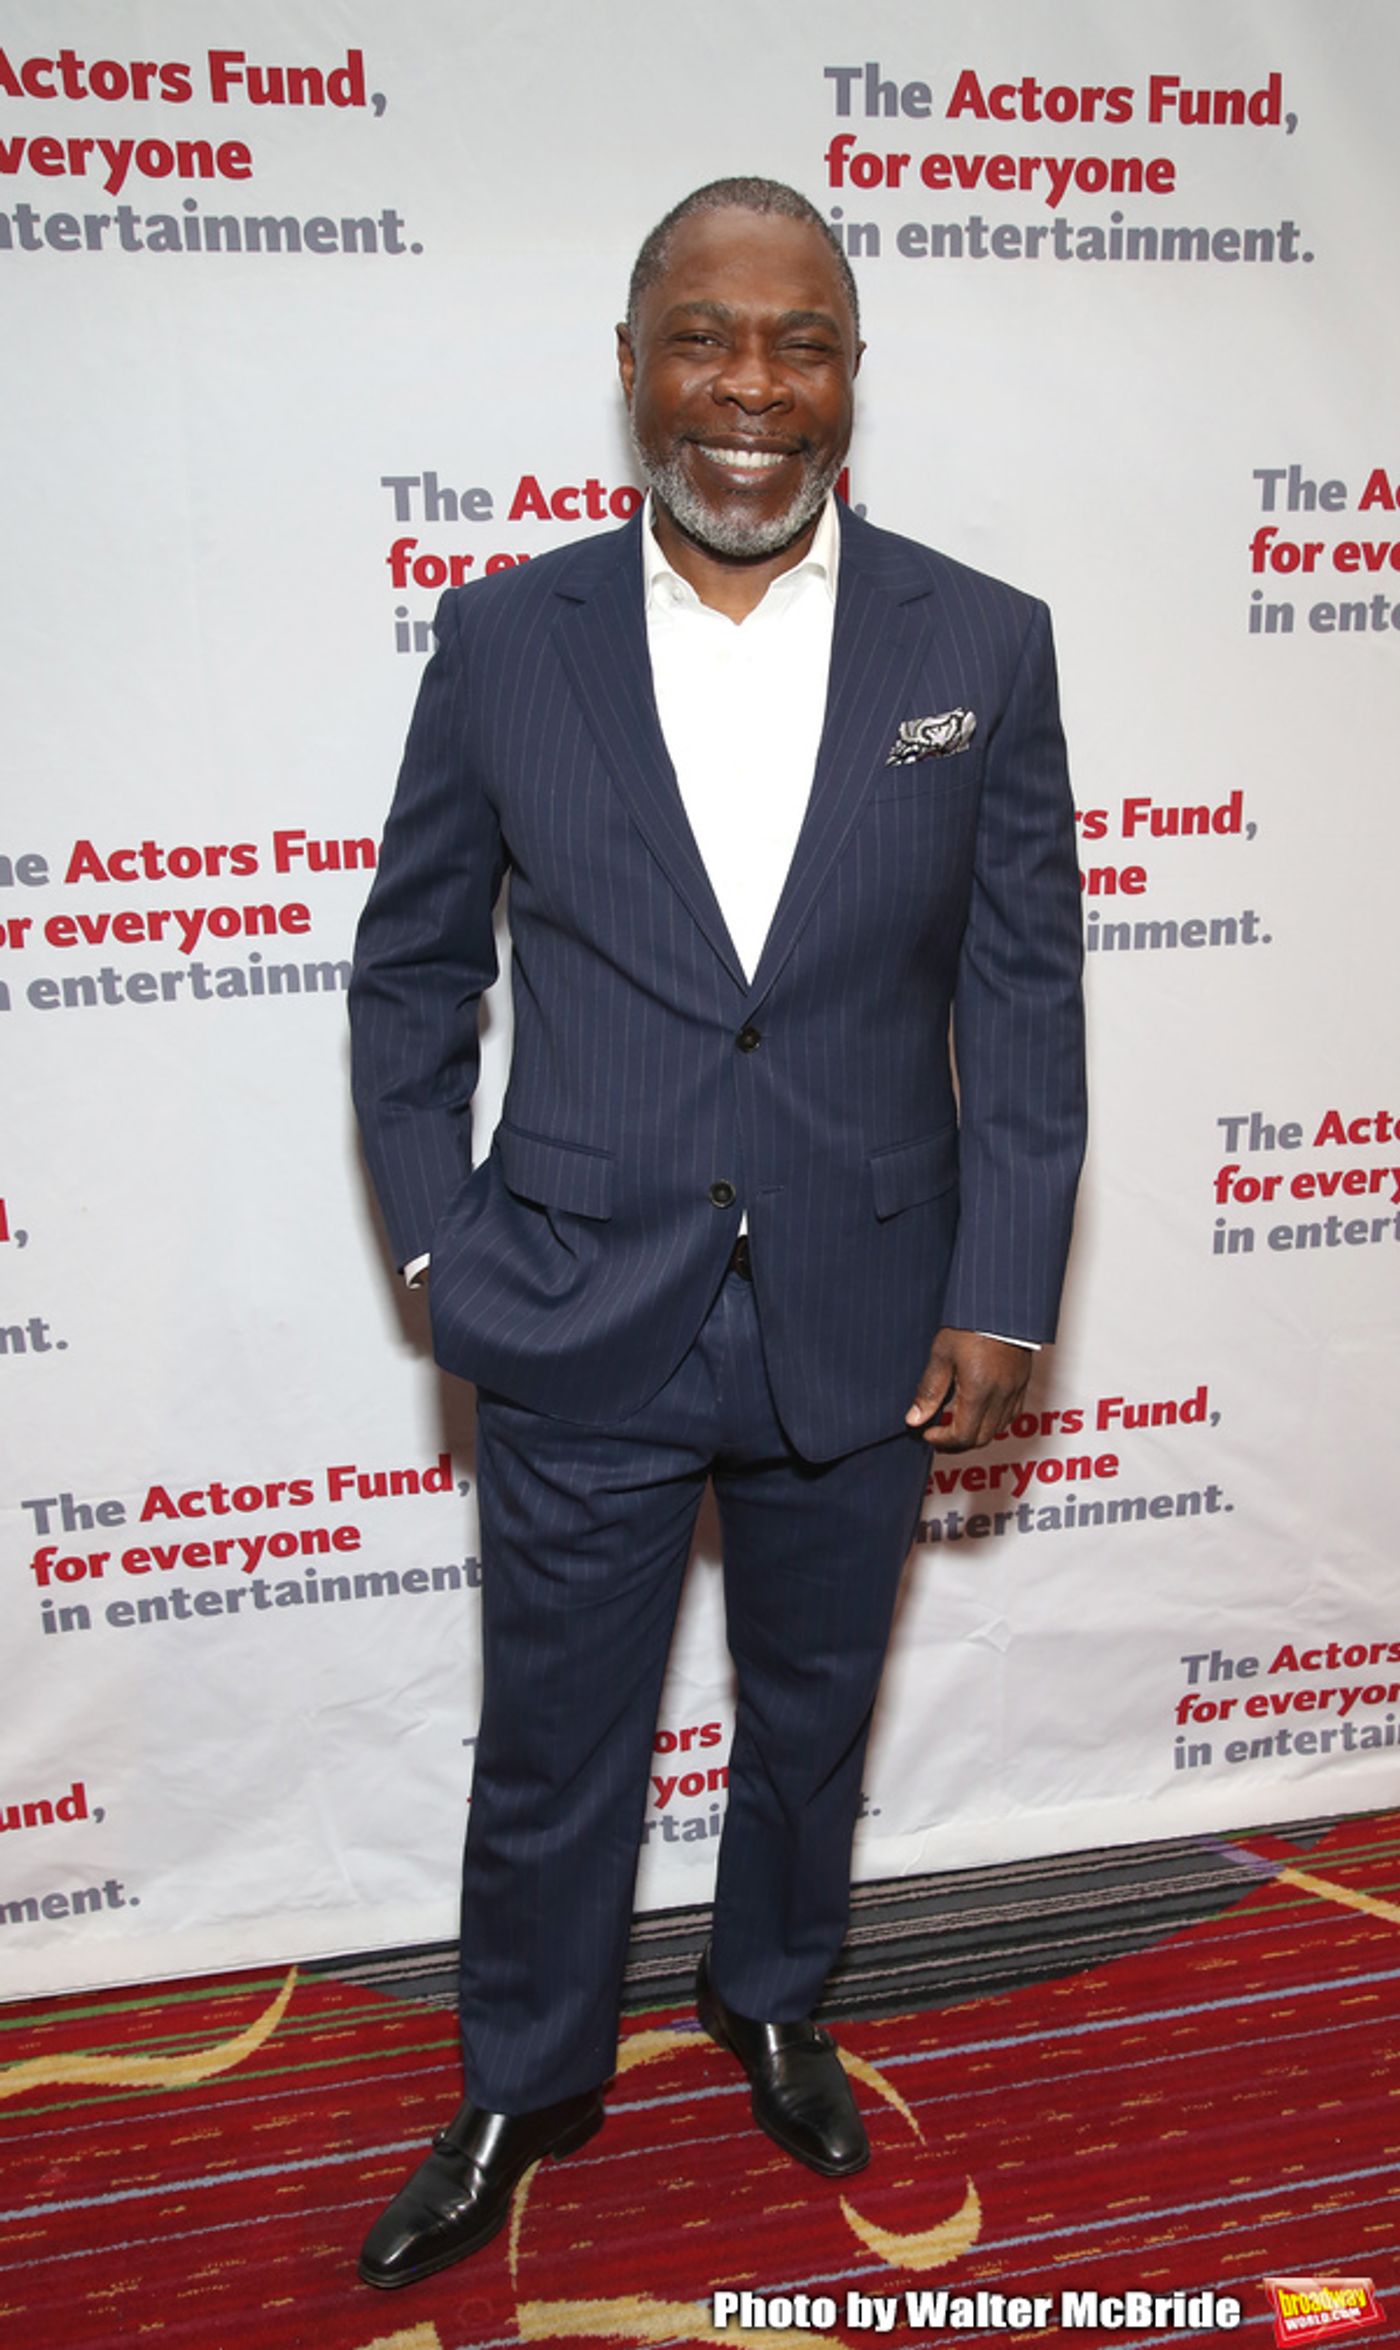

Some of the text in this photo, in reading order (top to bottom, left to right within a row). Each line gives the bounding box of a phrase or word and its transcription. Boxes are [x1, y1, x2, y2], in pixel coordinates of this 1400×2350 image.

[207, 48, 386, 116] Fund,
[823, 61, 1297, 134] The Actors Fund,
[0, 136, 253, 197] veryone
[823, 133, 1176, 209] for everyone
[829, 203, 1315, 264] in entertainment.
[380, 471, 647, 522] The Acto
[1252, 464, 1348, 513] The
[387, 537, 474, 588] for
[1248, 526, 1325, 574] for
[1248, 589, 1295, 634] in
[1121, 790, 1257, 840] Fund,
[64, 839, 259, 884] Actors
[273, 829, 381, 874] Fun
[1079, 866, 1147, 895] ne
[44, 902, 311, 955] everyone
[1086, 909, 1273, 953] inment.
[26, 952, 354, 1010] entertainm
[1217, 1110, 1400, 1153] The Act
[1213, 1164, 1284, 1205] for
[1213, 1217, 1255, 1255] in
[993, 1408, 1084, 1440] ors
[1096, 1385, 1220, 1431] Fund,
[20, 1453, 470, 1536] The Actors Fund,
[29, 1525, 361, 1587] for everyone
[40, 1598, 91, 1635] in
[1180, 1649, 1260, 1685] The
[1174, 1693, 1239, 1726] for
[1174, 1713, 1400, 1770] in entertai
